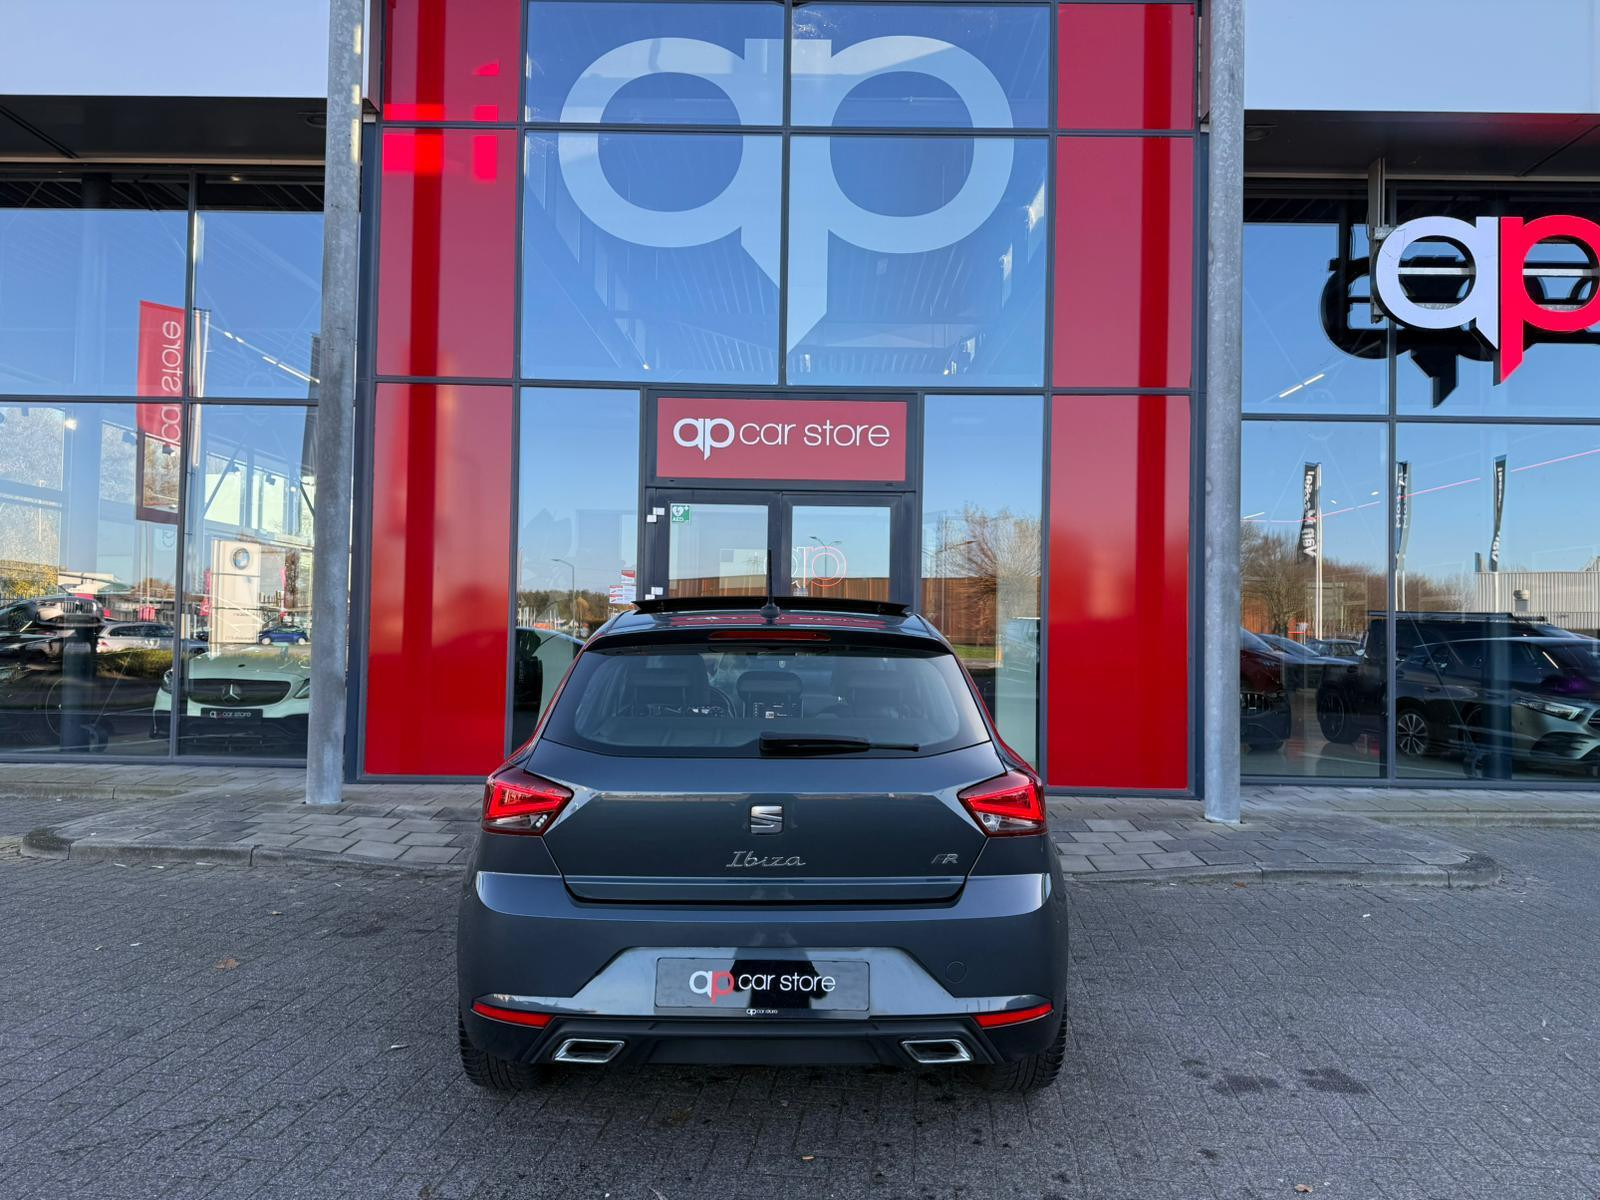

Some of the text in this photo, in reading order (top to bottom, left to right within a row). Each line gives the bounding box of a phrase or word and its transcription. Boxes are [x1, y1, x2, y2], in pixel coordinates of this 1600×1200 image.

[673, 417, 891, 461] ap car store
[725, 850, 806, 868] Ibiza
[688, 970, 836, 1005] ap car store
